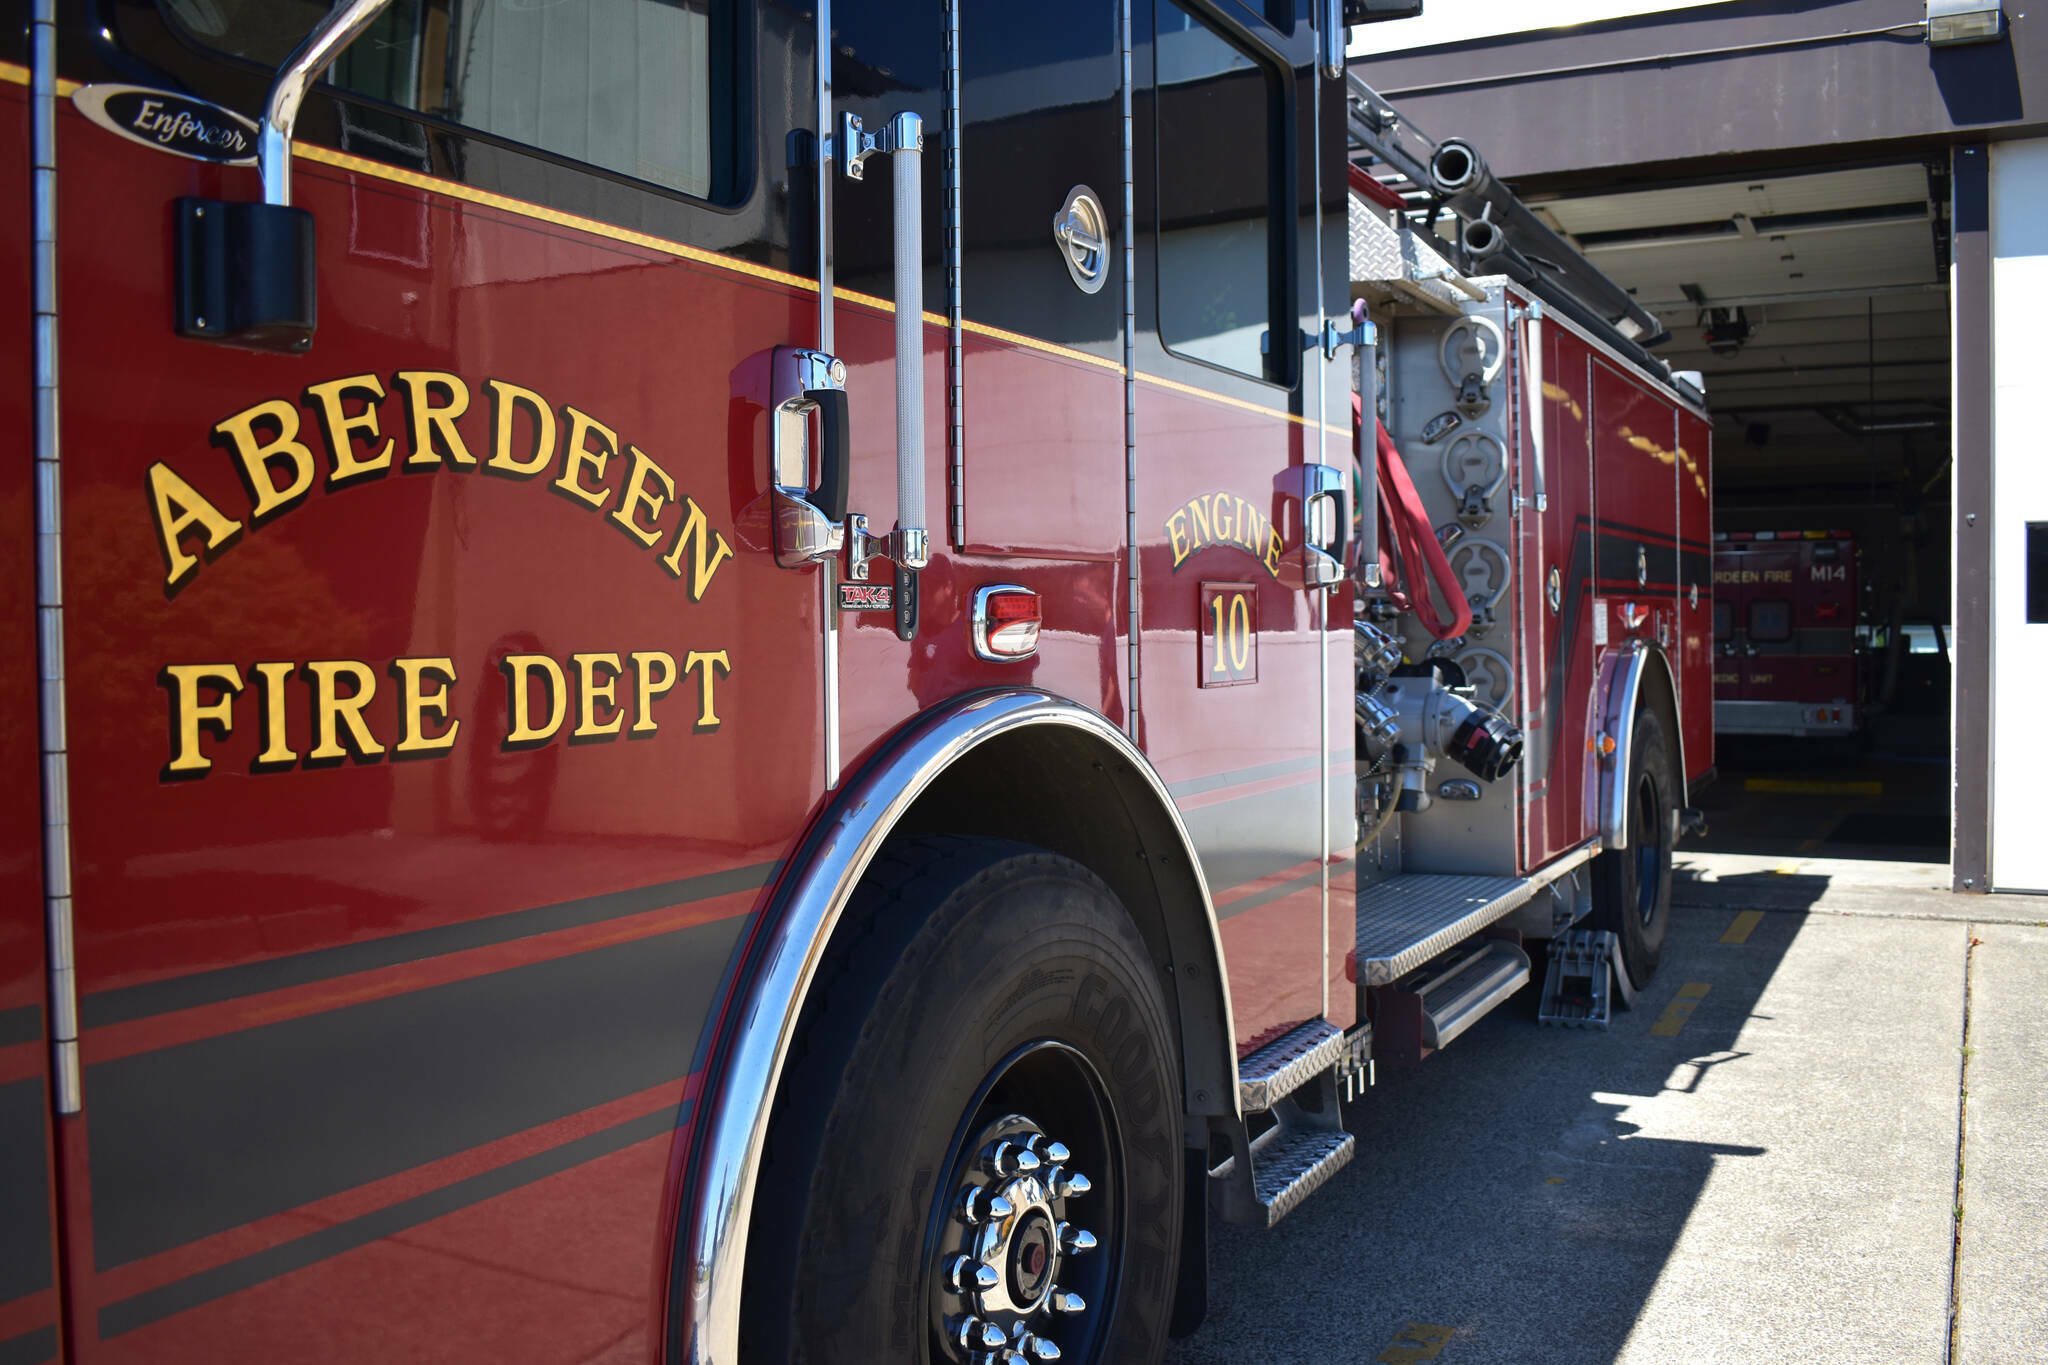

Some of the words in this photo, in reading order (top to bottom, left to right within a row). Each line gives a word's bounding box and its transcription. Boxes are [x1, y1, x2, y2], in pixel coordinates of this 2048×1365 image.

[133, 100, 247, 152] Enforcer
[145, 370, 733, 600] ABERDEEN
[1165, 491, 1283, 579] ENGINE
[1713, 570, 1760, 585] RDEEN
[1764, 570, 1793, 584] FIRE
[1211, 592, 1250, 676] 10
[159, 656, 461, 783] FIRE
[501, 648, 731, 750] DEPT
